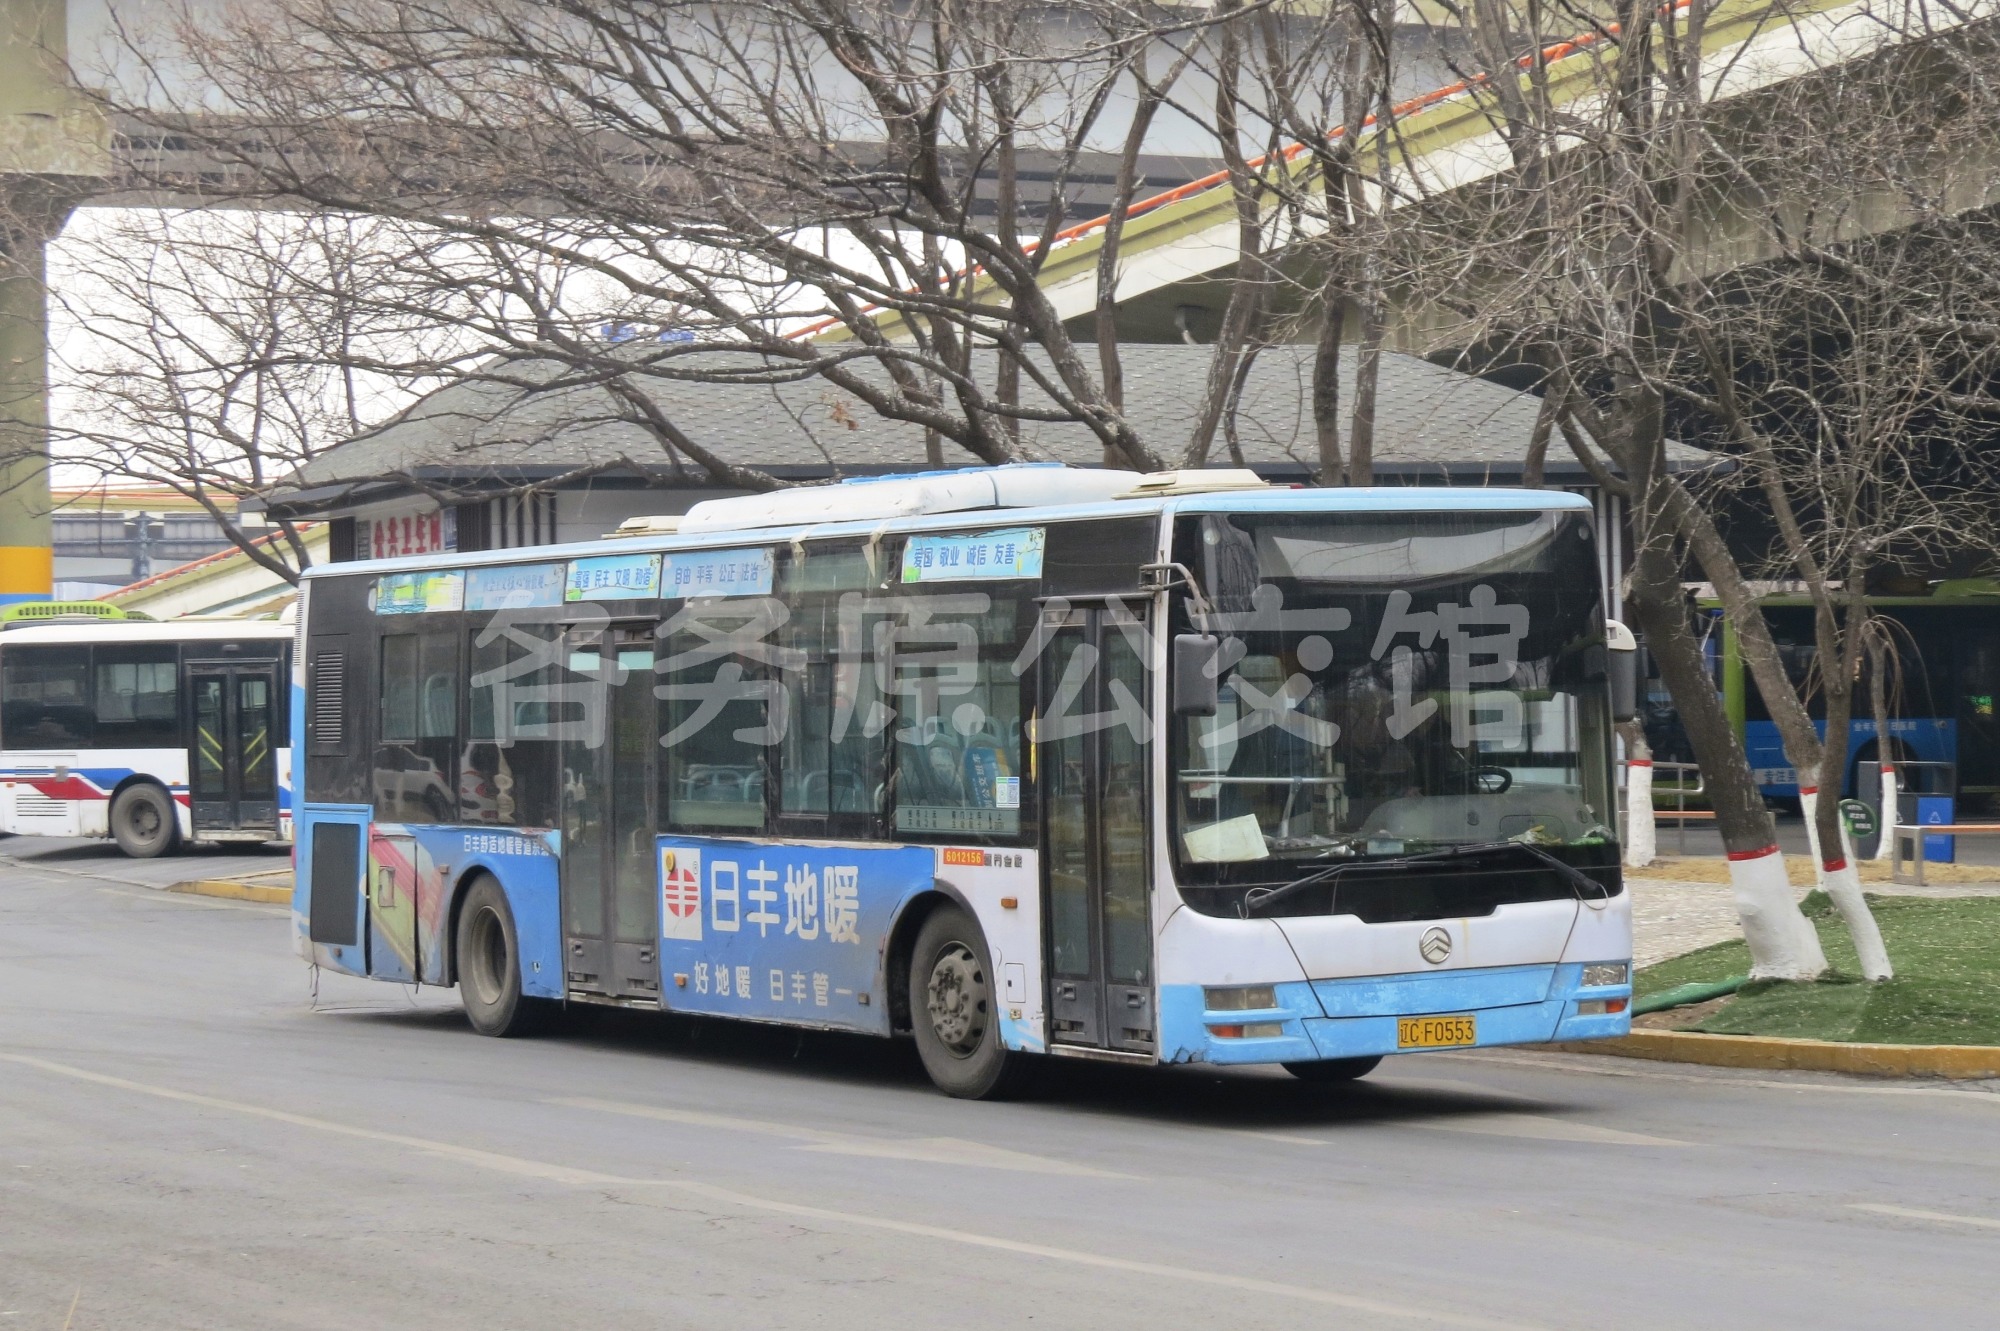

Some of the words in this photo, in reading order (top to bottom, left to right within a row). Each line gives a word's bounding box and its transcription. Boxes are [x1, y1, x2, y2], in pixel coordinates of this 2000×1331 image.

[914, 547, 933, 568] 爱国
[940, 546, 960, 567] 敬业
[966, 544, 987, 565] 诚信
[994, 543, 1015, 565] 友善
[595, 569, 610, 587] 民主
[615, 568, 631, 586] 文明
[675, 565, 691, 585] 自由
[697, 564, 713, 584] 平等
[719, 563, 736, 583] 公正
[741, 562, 759, 582] 法治
[946, 851, 981, 863] 6012156
[711, 859, 860, 944] 日丰地暖
[694, 961, 751, 999] 好地暖
